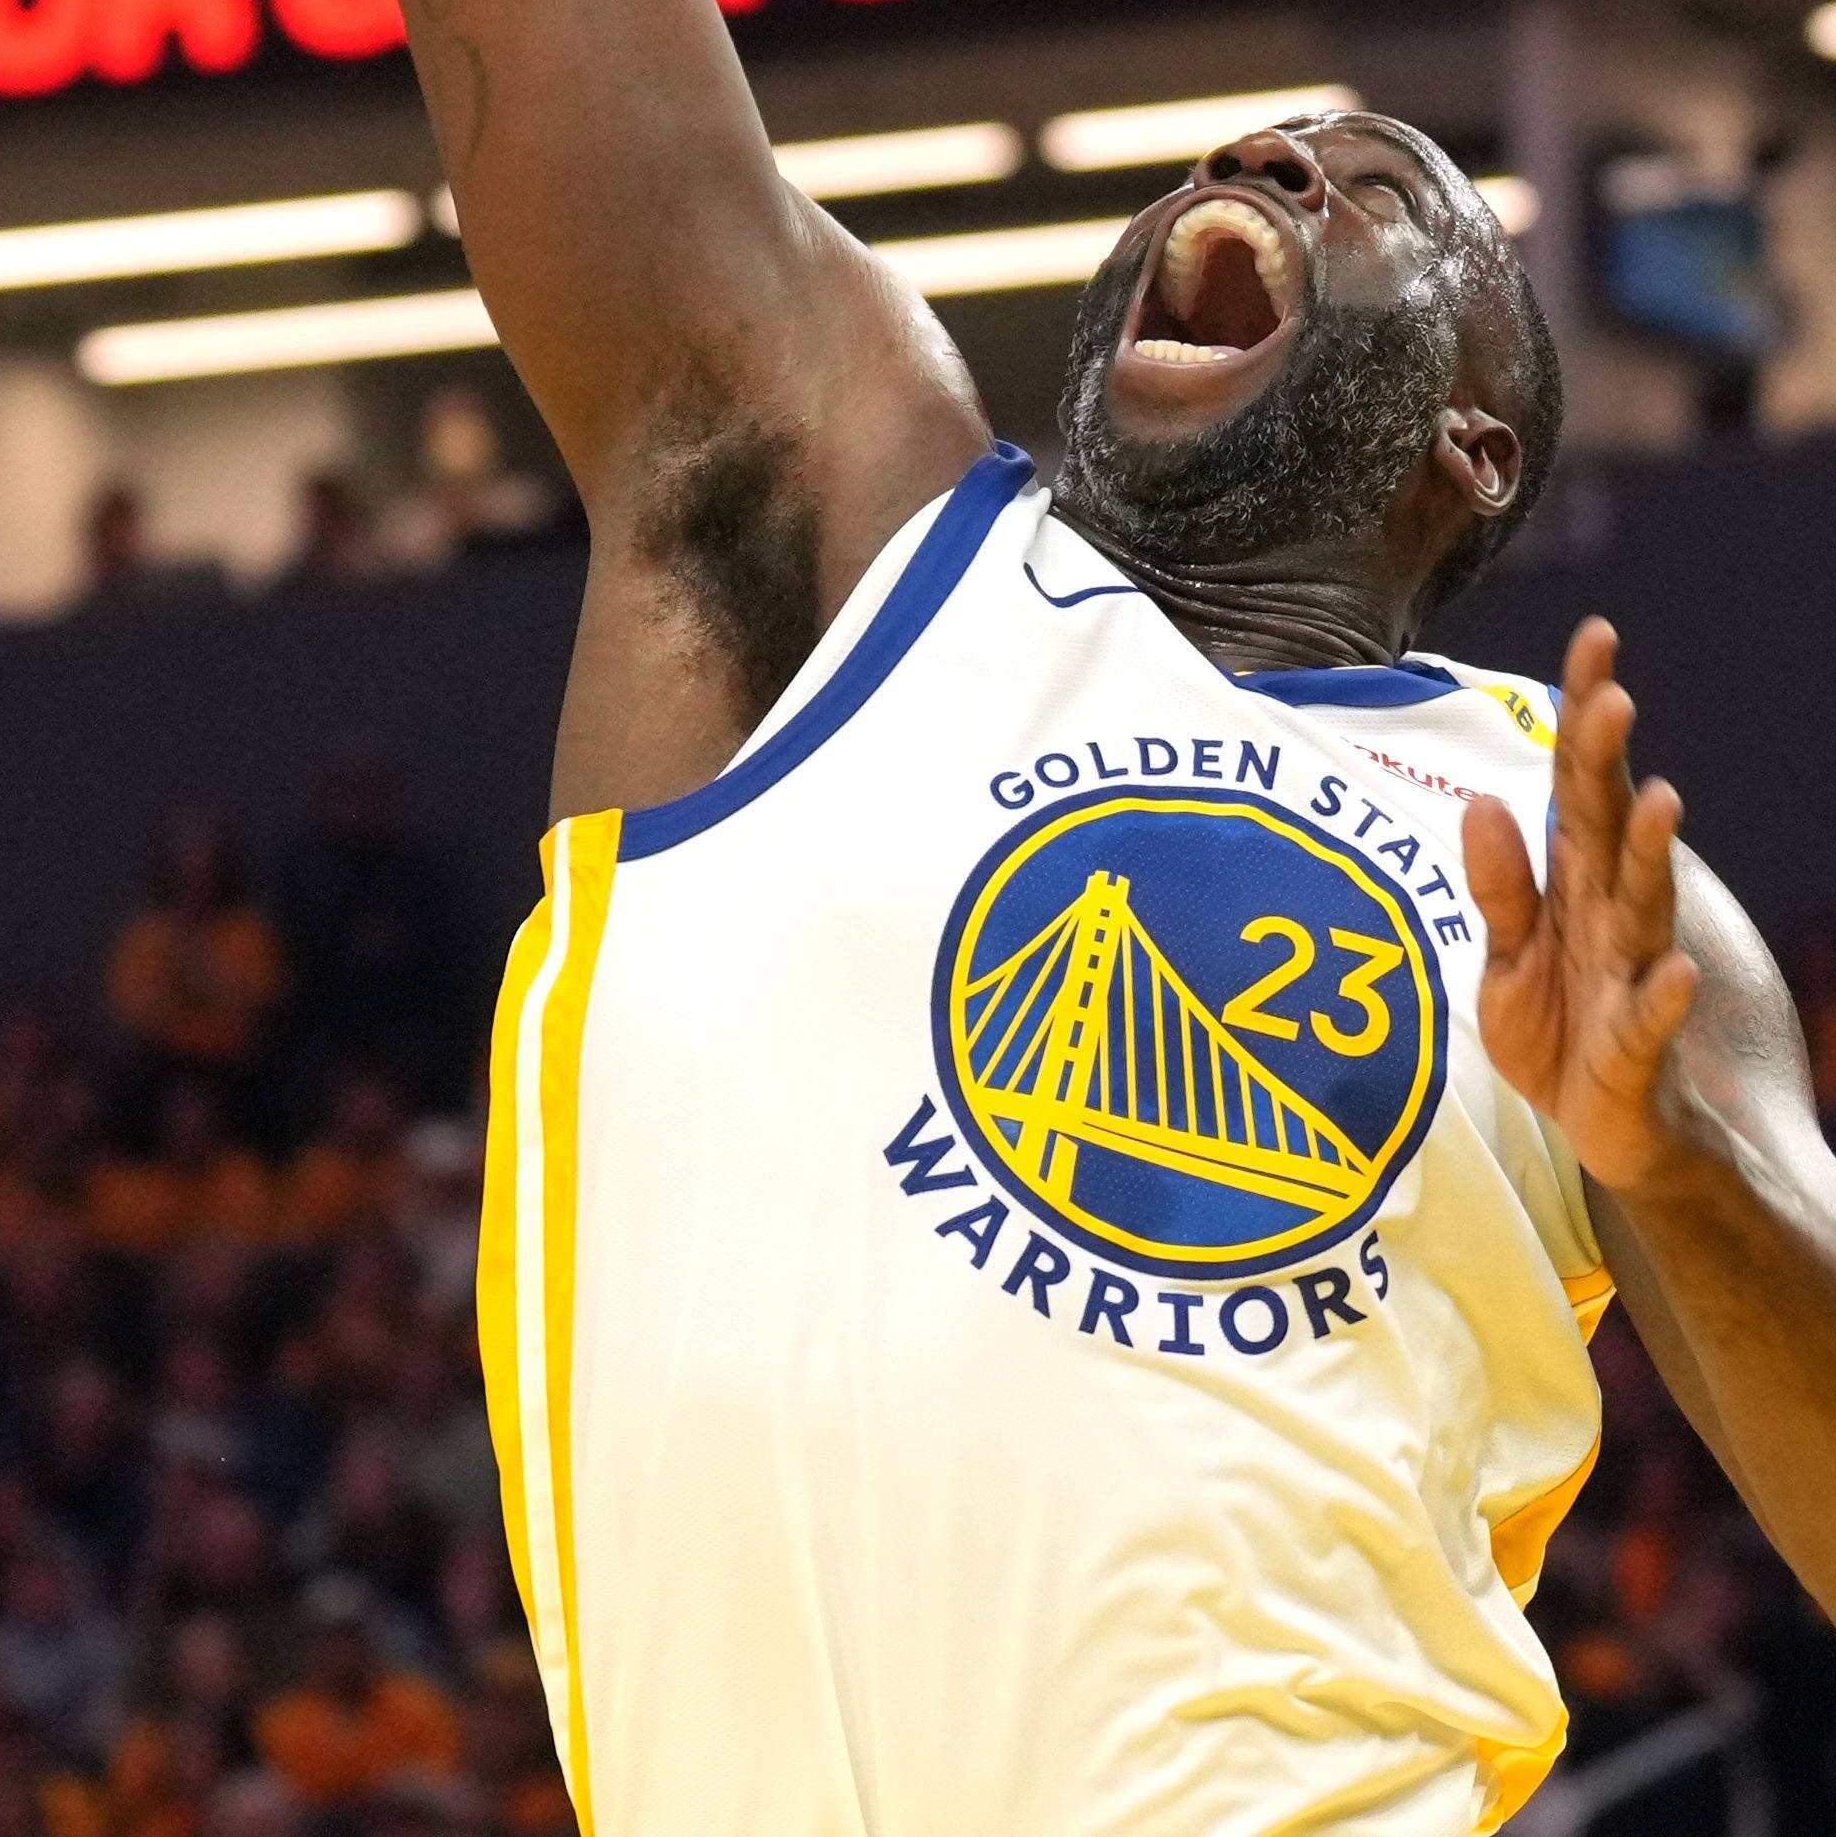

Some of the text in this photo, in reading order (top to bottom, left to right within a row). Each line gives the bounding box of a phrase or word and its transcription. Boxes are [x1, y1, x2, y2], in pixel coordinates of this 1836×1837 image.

[1504, 690, 1536, 734] 16
[988, 736, 1473, 948] GOLDEN STATE
[1221, 915, 1405, 1058] 23
[882, 1094, 1391, 1358] WARRIORS
